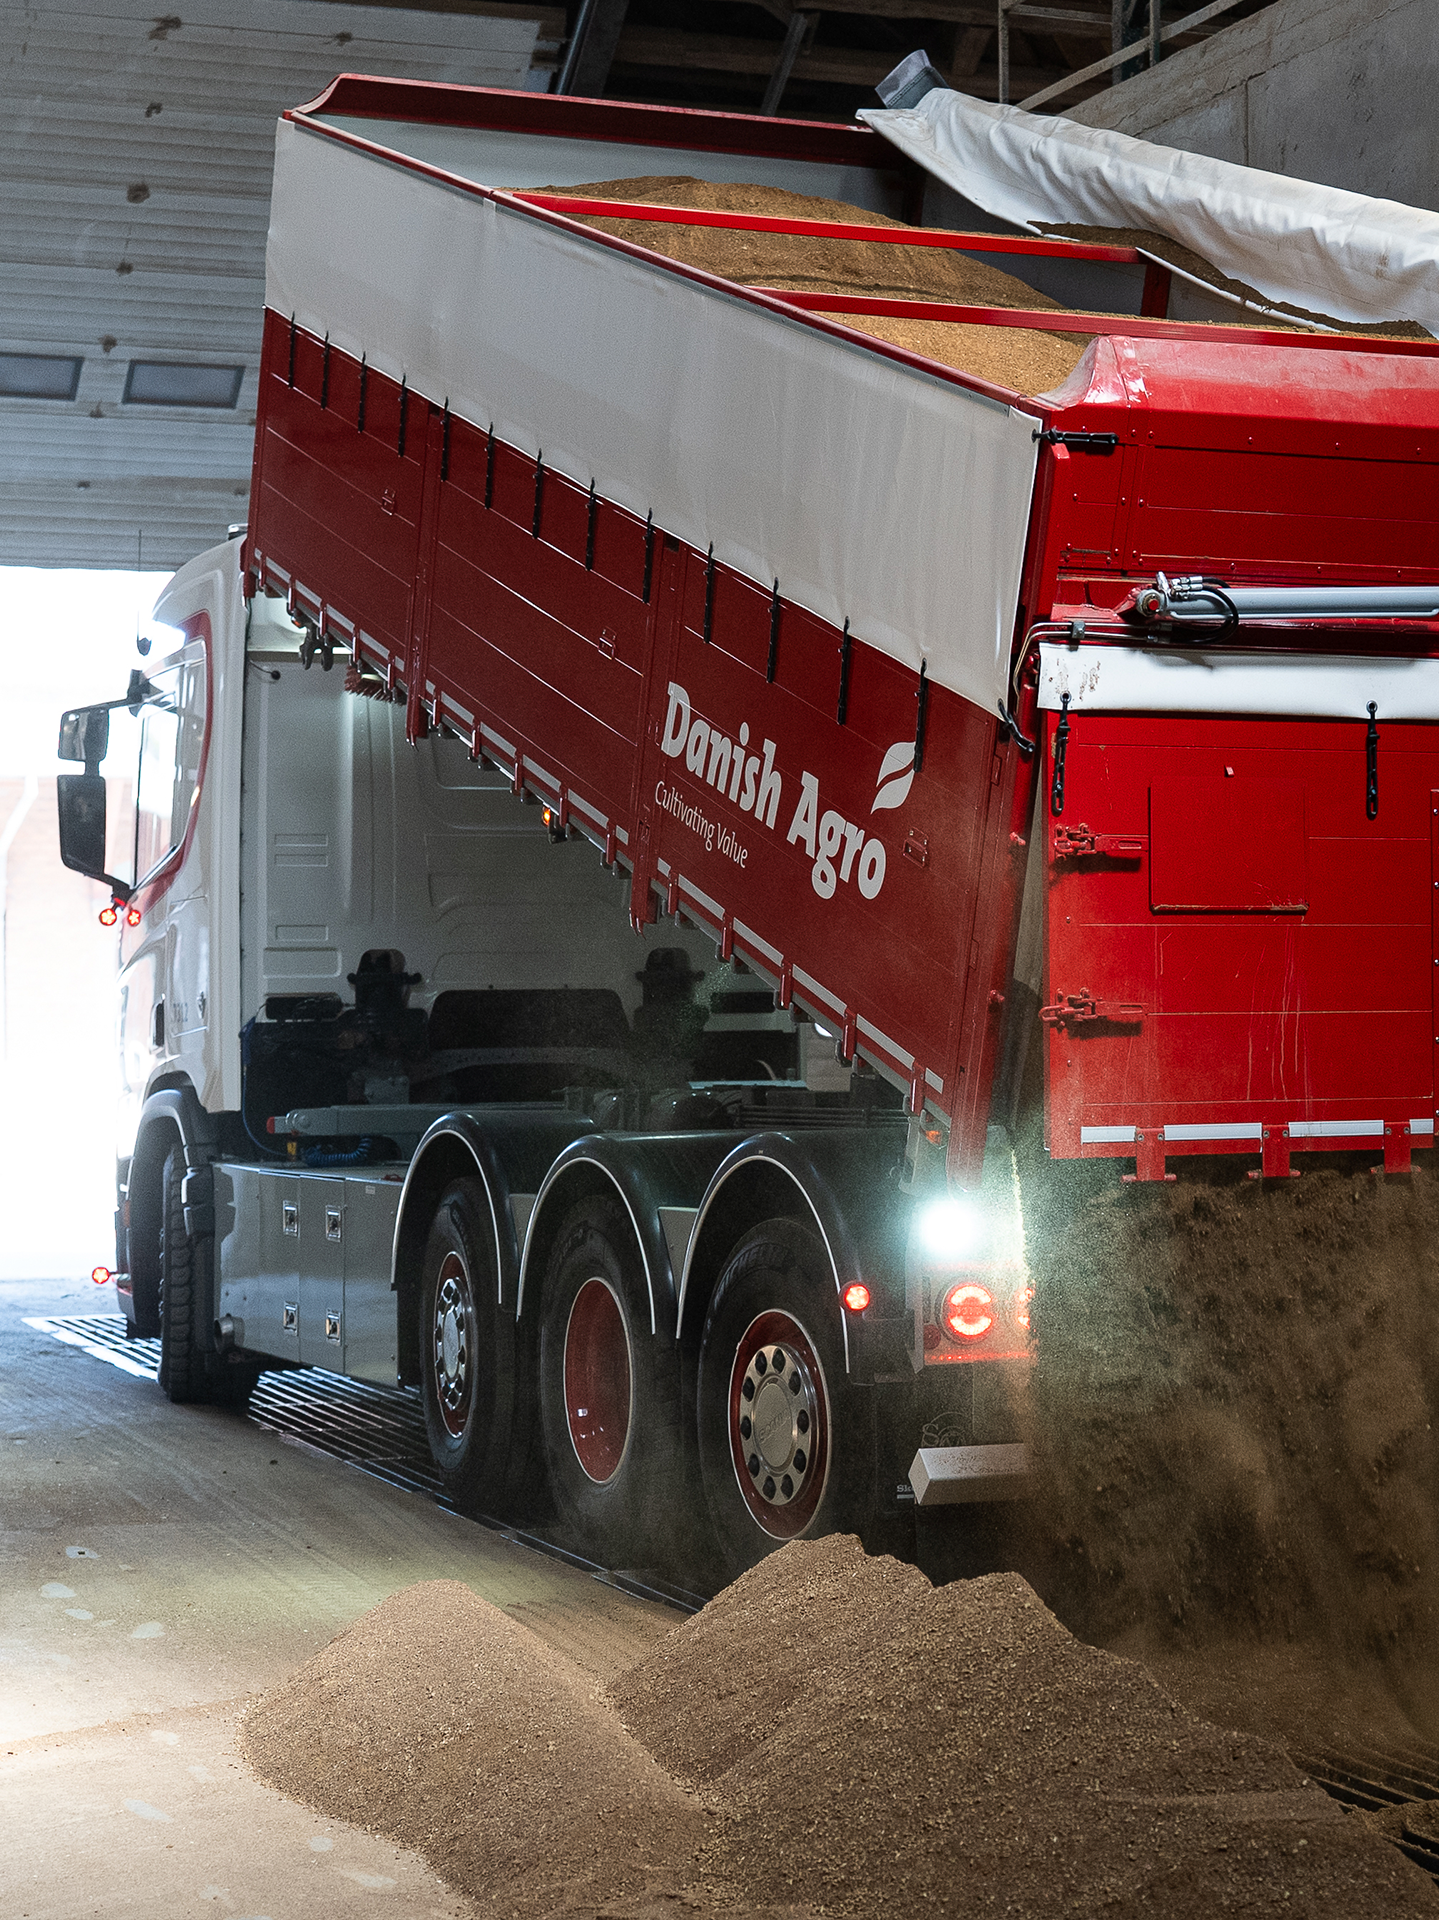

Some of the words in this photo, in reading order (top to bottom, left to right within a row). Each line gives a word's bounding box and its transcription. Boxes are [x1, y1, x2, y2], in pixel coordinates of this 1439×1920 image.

[655, 780, 715, 852] Cultivating
[717, 822, 748, 868] Value
[661, 681, 782, 830] Danish
[786, 770, 886, 900] Agro
